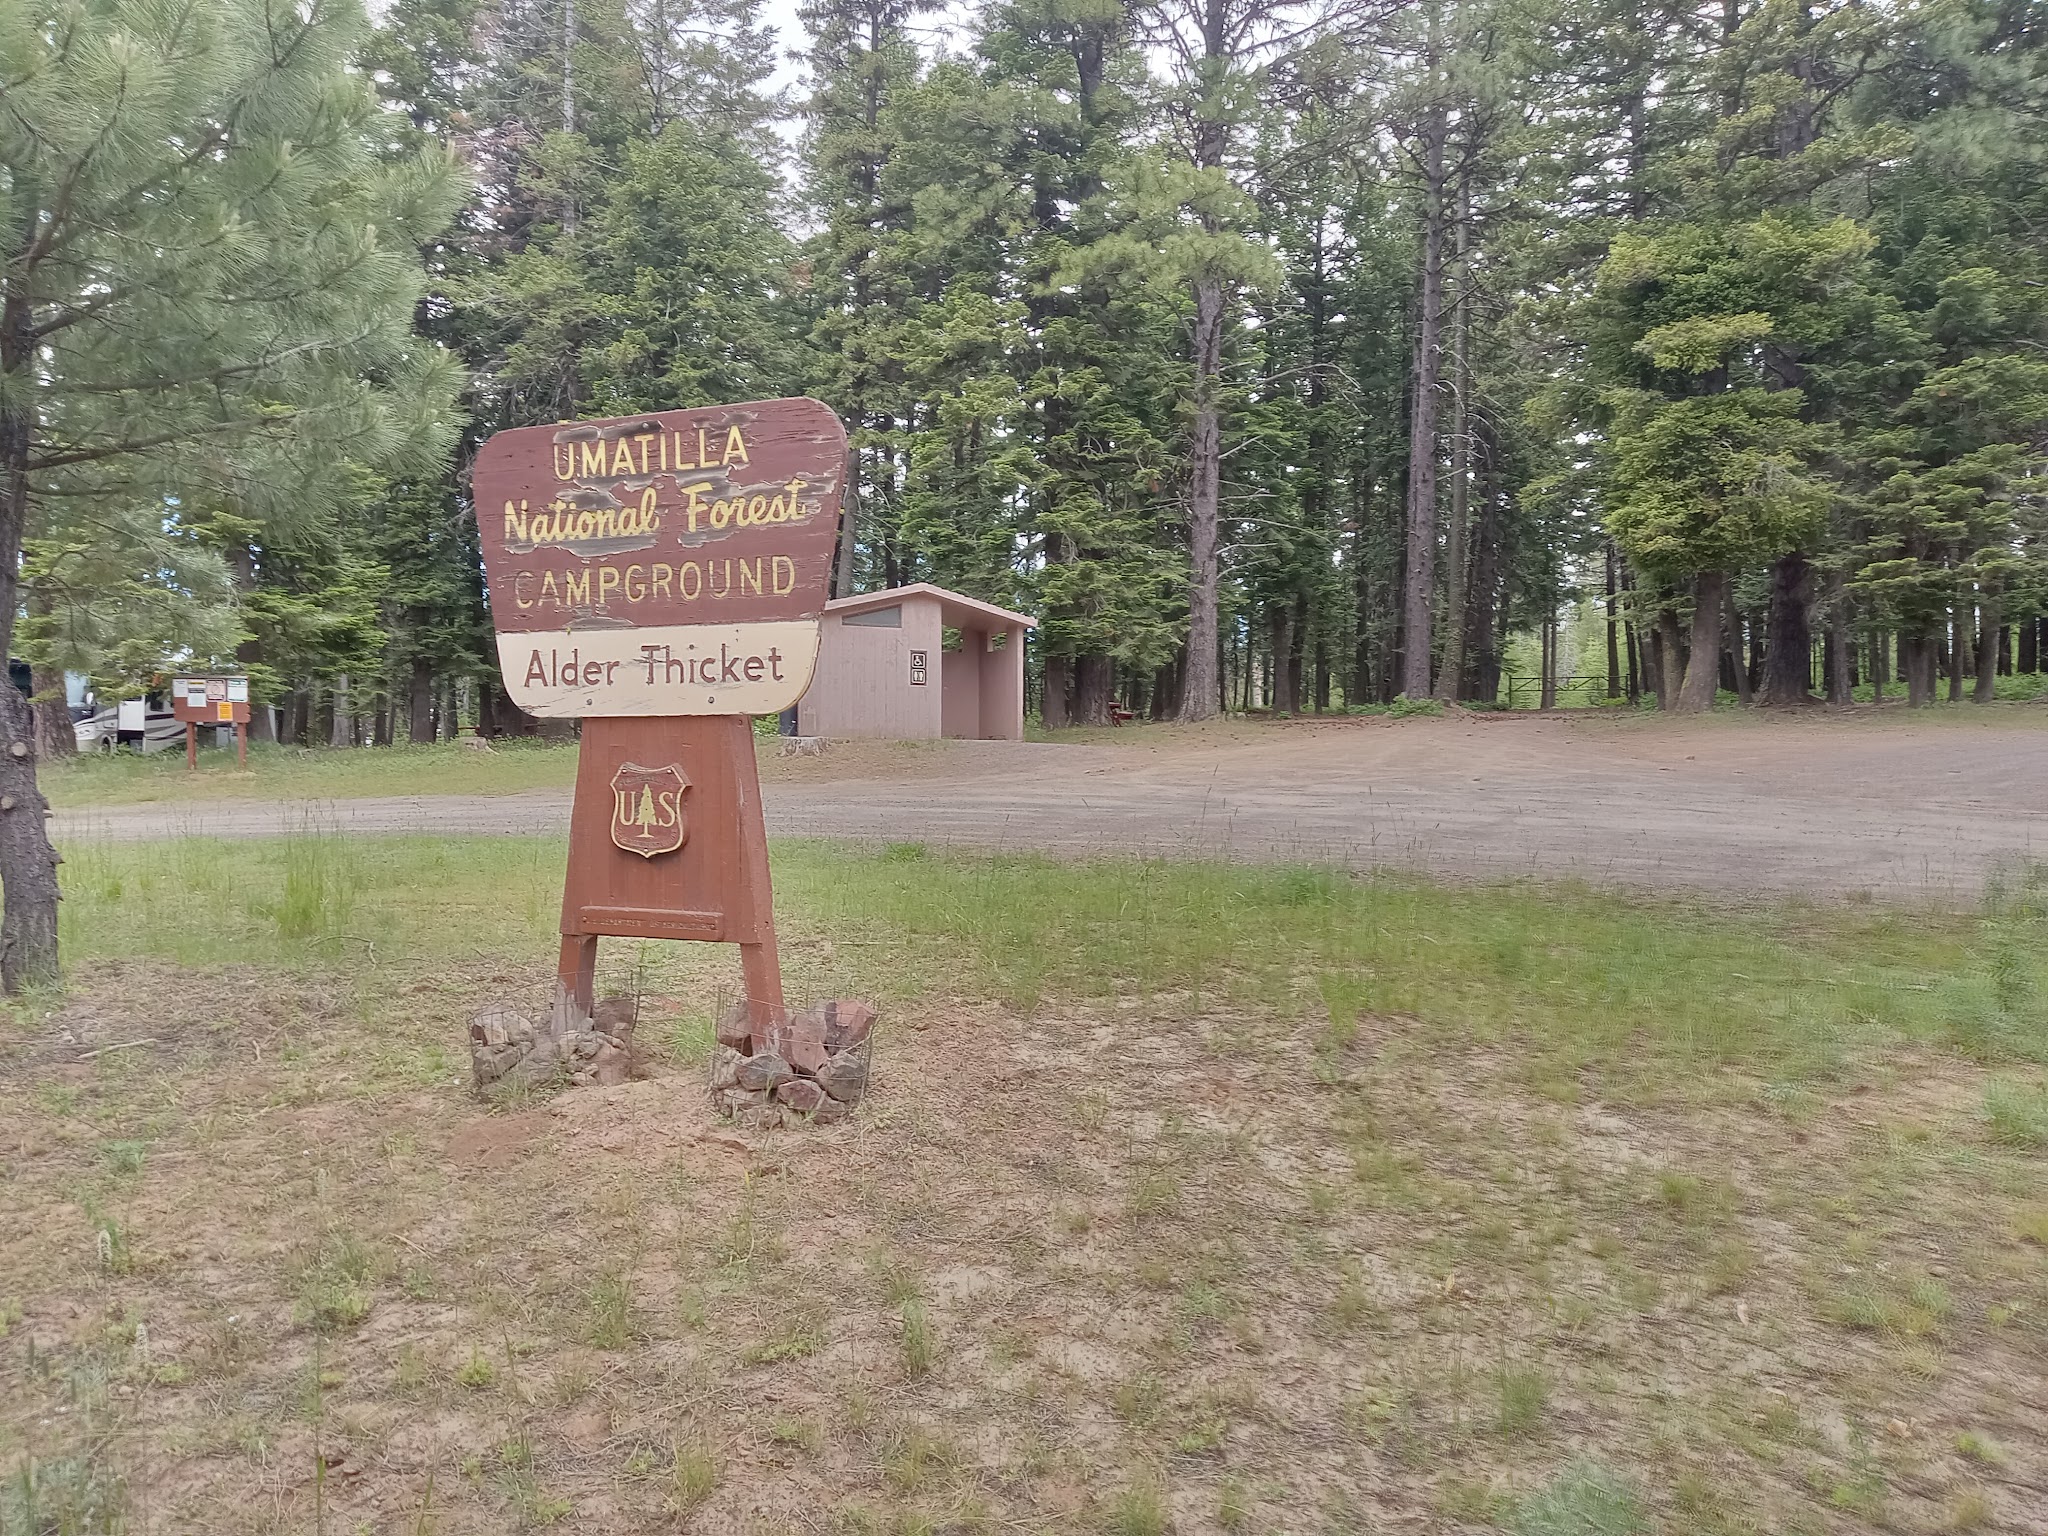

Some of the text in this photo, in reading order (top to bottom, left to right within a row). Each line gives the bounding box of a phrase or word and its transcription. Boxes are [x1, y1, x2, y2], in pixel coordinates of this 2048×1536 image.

[553, 425, 749, 481] UMATILLA
[503, 478, 808, 544] National Forest
[515, 556, 796, 609] CAMPGROUND
[524, 643, 784, 688] Alder Thicket
